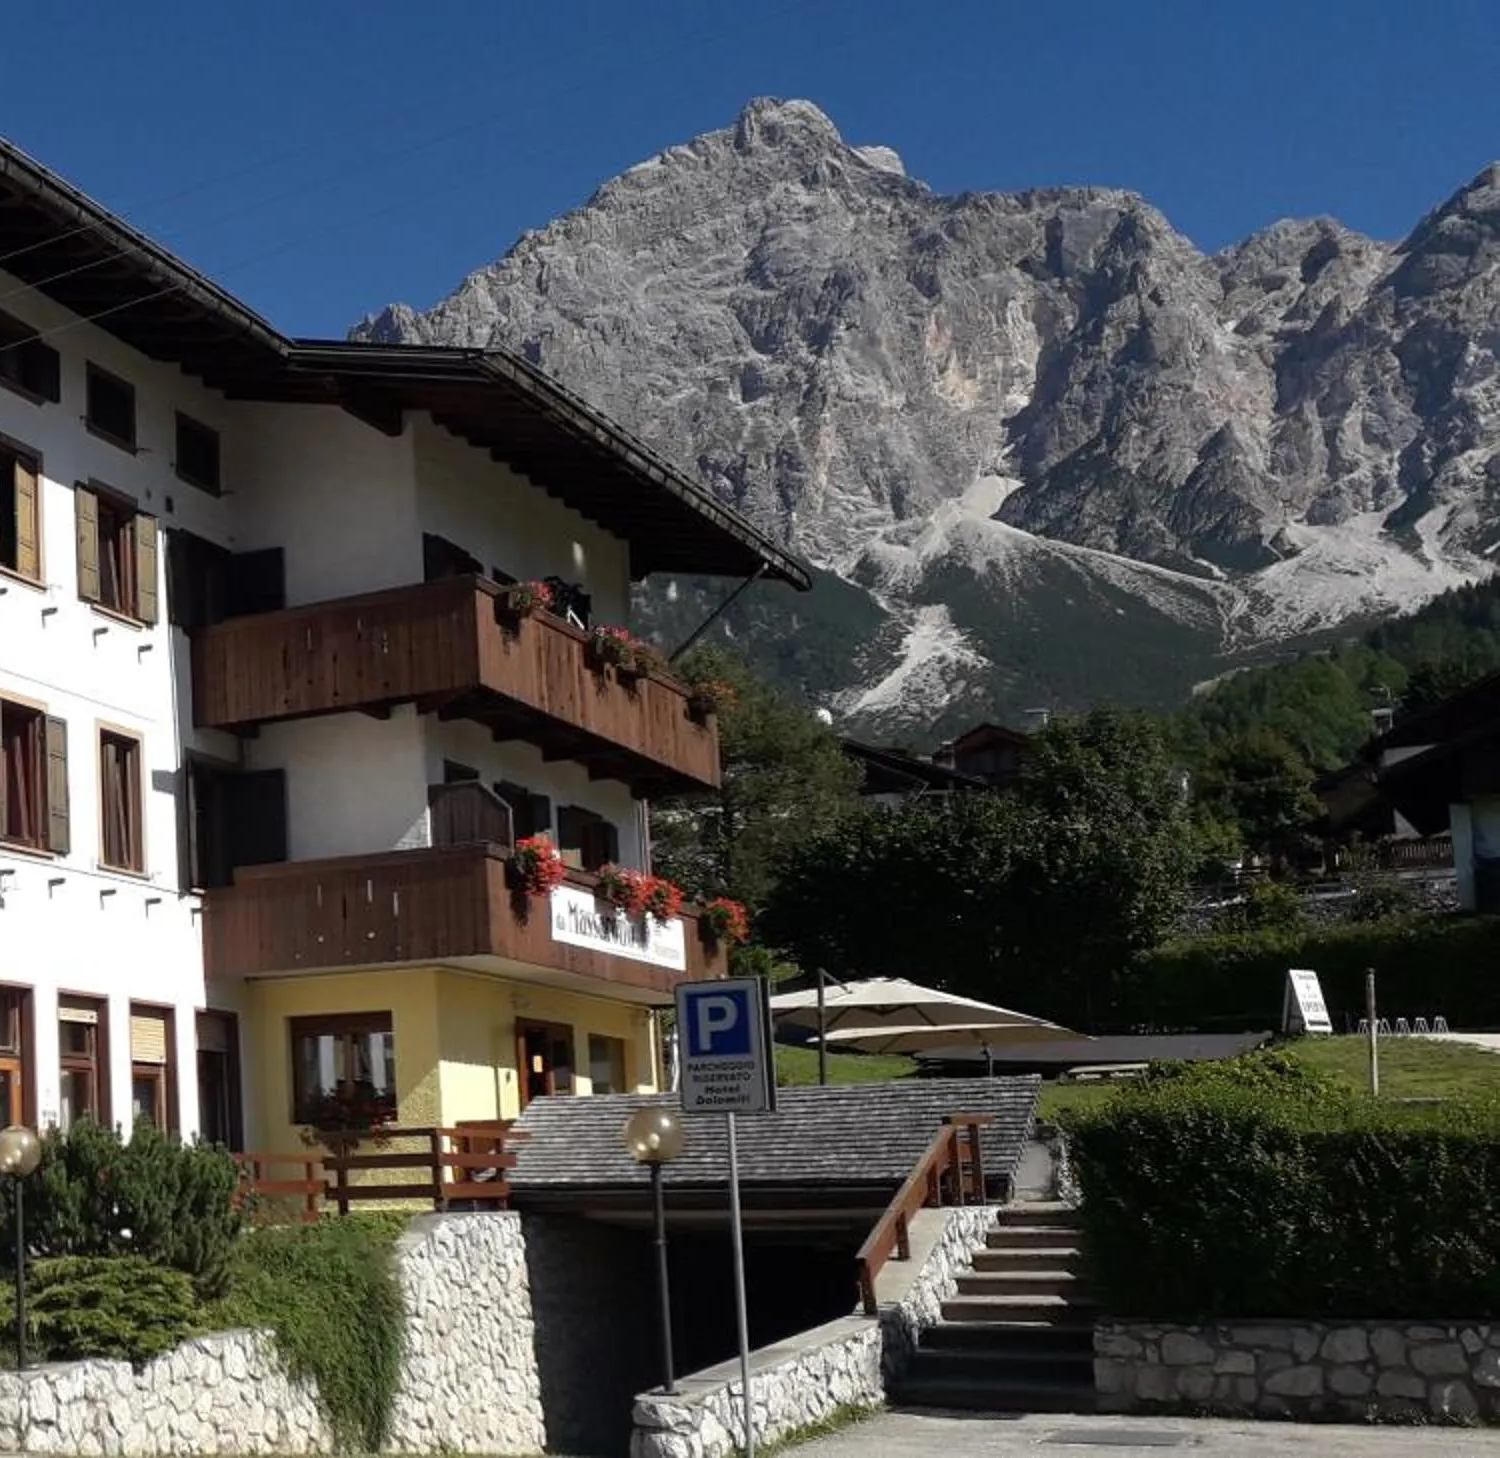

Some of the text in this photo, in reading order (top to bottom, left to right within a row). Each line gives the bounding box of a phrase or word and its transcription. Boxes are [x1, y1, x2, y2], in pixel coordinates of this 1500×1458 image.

[697, 996, 738, 1051] P
[687, 1061, 755, 1073] PARCHEGGIO
[693, 1071, 751, 1083] RISERVATO
[705, 1083, 740, 1094] Hotel
[695, 1093, 751, 1105] Dolomiti
